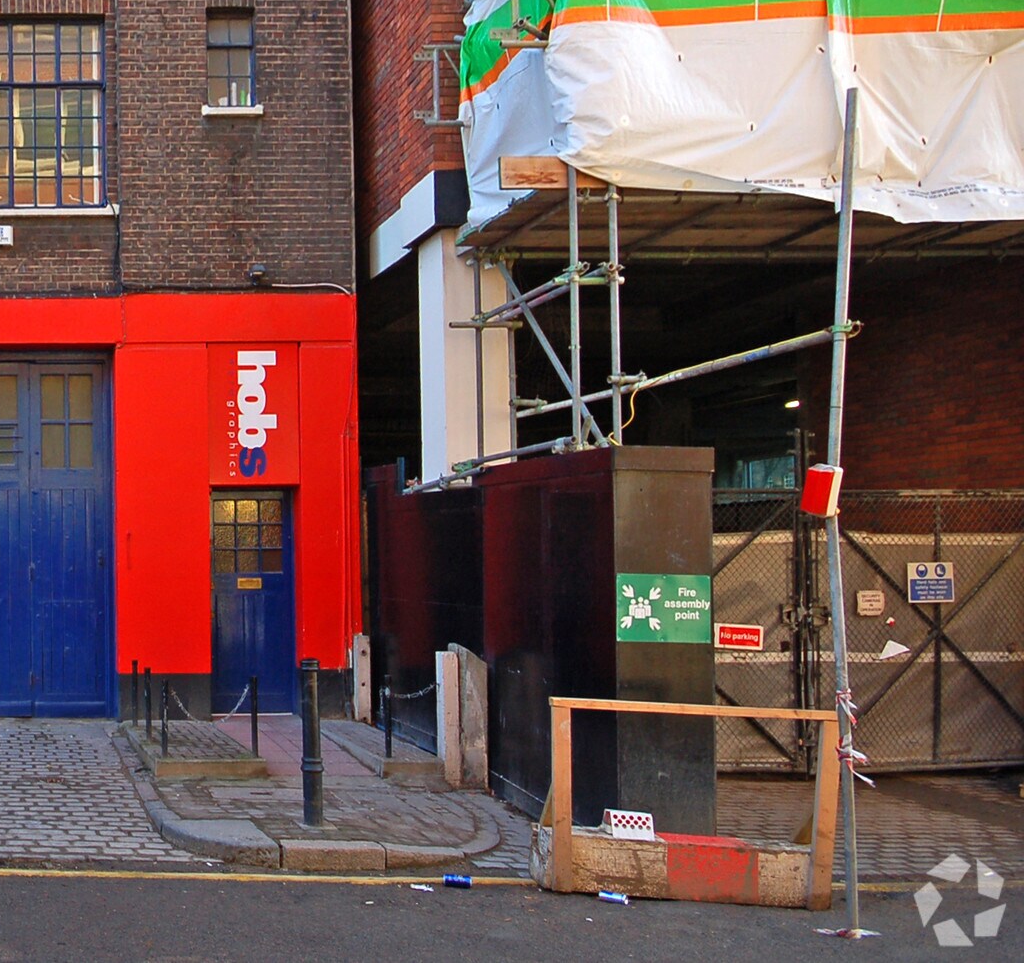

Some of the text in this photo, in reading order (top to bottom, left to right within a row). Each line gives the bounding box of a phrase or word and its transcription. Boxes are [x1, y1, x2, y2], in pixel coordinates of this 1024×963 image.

[237, 350, 277, 477] hobs
[678, 587, 696, 597] Fire
[664, 599, 711, 610] assembly
[674, 610, 700, 621] point
[720, 631, 759, 642] No parking
